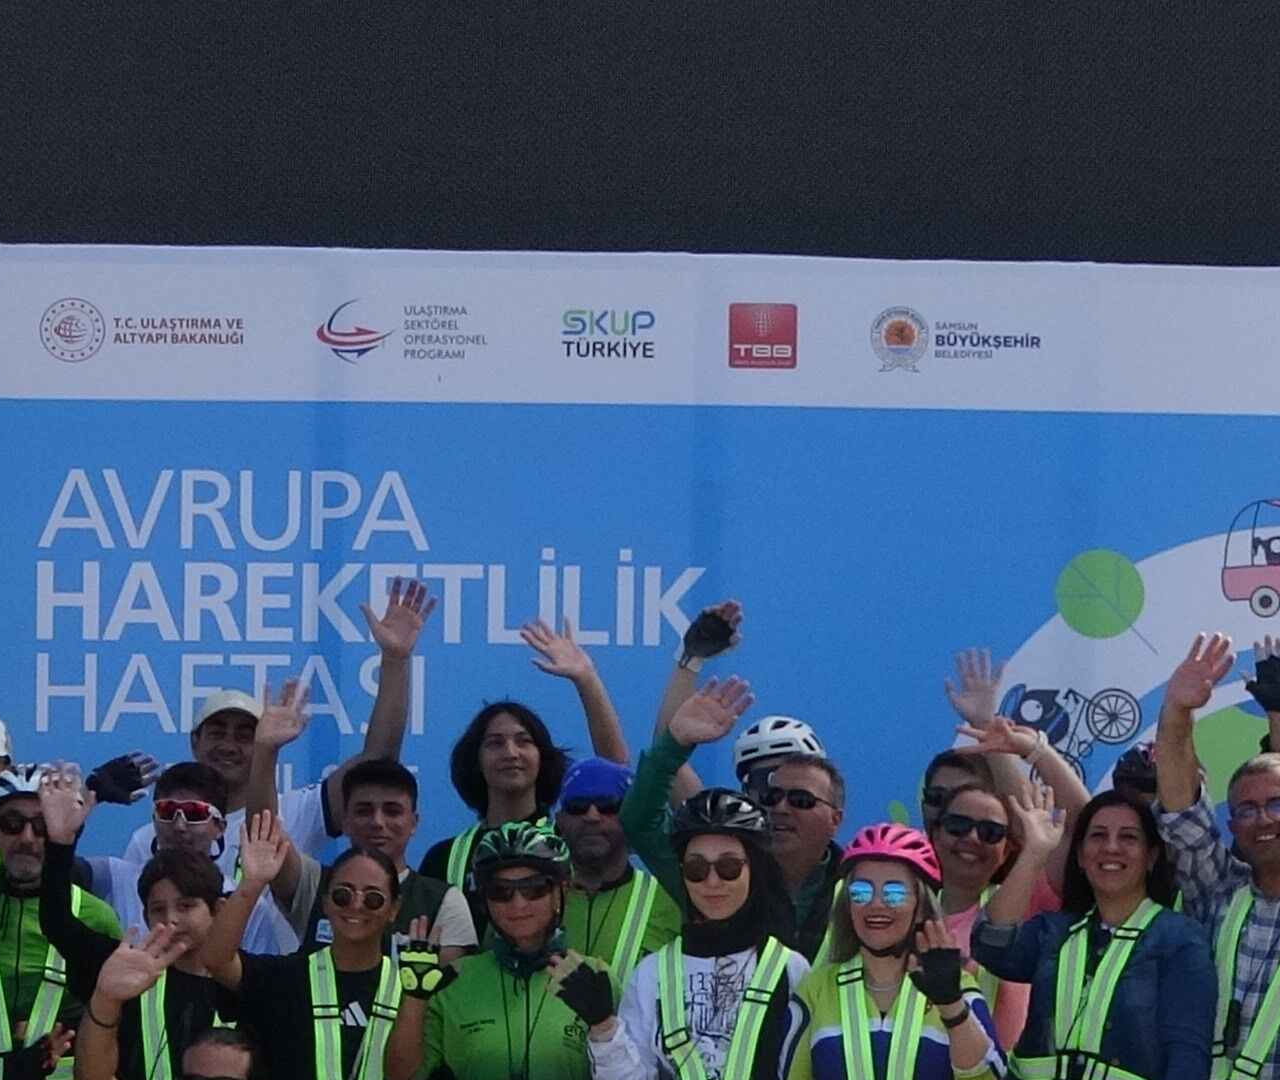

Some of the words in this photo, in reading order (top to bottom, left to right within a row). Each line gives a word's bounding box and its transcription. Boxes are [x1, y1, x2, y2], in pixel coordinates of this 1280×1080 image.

[403, 305, 468, 317] ULAŞTIRMA
[113, 317, 137, 329] T.C.
[140, 317, 221, 332] ULAŞTIRMA
[226, 317, 244, 330] VE
[403, 318, 459, 331] SEKTÖREL
[561, 309, 656, 336] SKUP
[935, 321, 978, 331] SAMSUN
[113, 332, 167, 344] ALTYAPI
[170, 331, 244, 345] BAKANLIĞI
[403, 334, 488, 346] OPERASYONEL
[934, 332, 1042, 350] BÜYÜKŞEHİR
[403, 348, 466, 360] PROGRAMI
[562, 338, 656, 359] TÜRKİYE
[733, 344, 792, 358] TBB
[934, 350, 994, 360] BELEDİYESİ
[37, 467, 431, 552] AVRUPA
[35, 546, 707, 647] HAREKETLİLİK
[35, 652, 426, 736] HAFTASI
